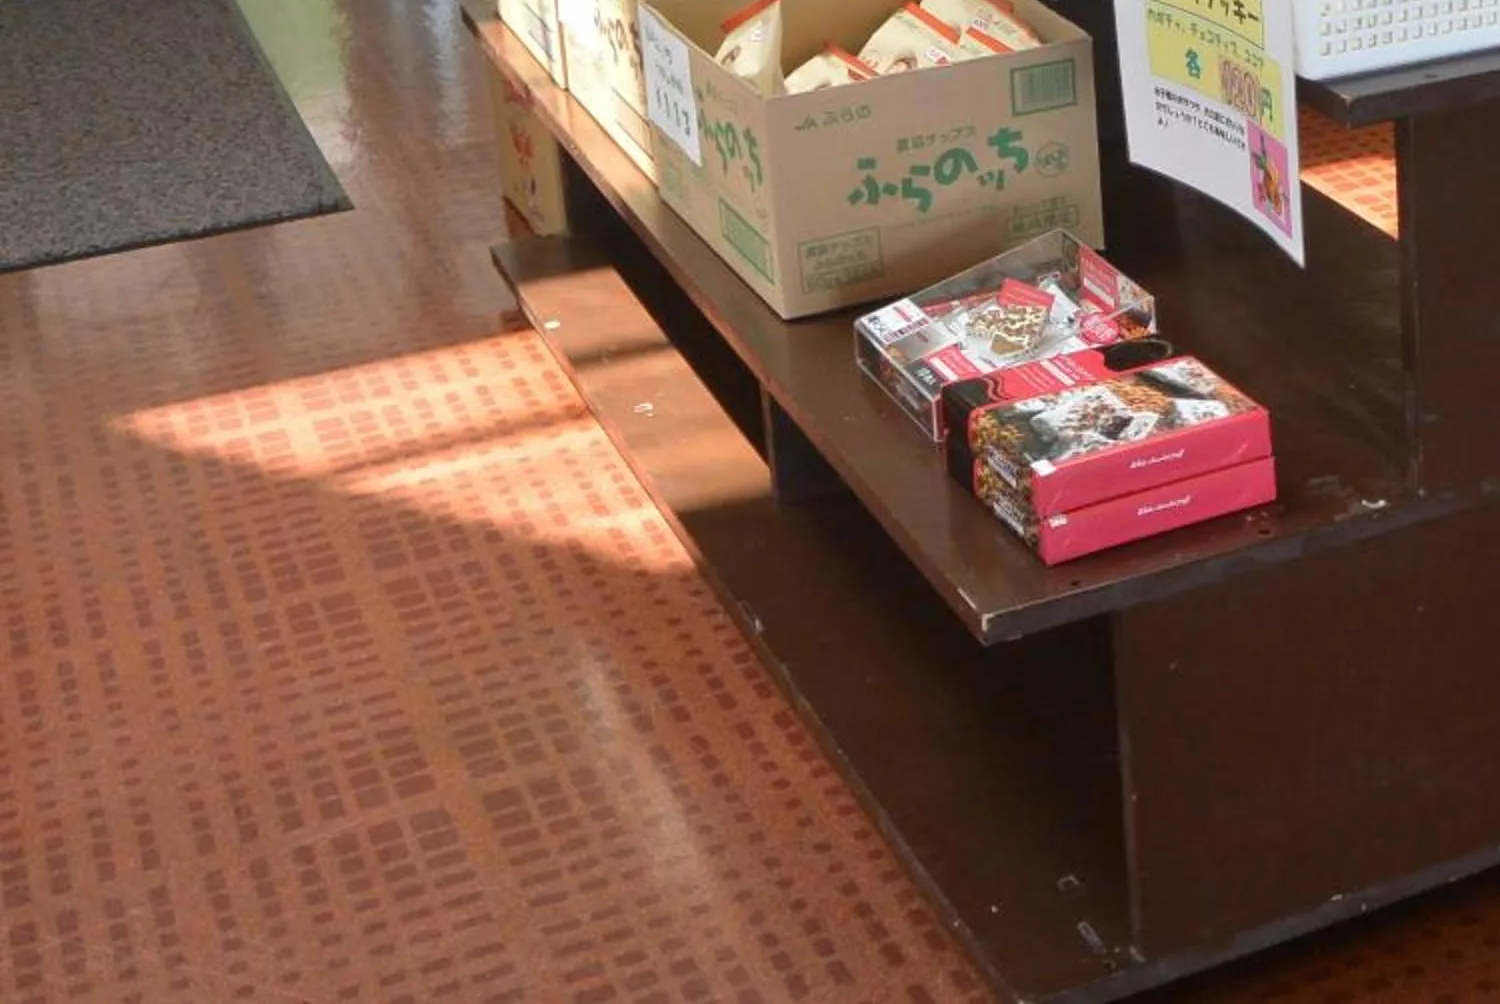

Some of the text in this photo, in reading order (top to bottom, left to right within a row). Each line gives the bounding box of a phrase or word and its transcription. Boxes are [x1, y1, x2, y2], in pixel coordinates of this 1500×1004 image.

[1185, 48, 1202, 80] 各
[847, 127, 1030, 214] ふらのっち
